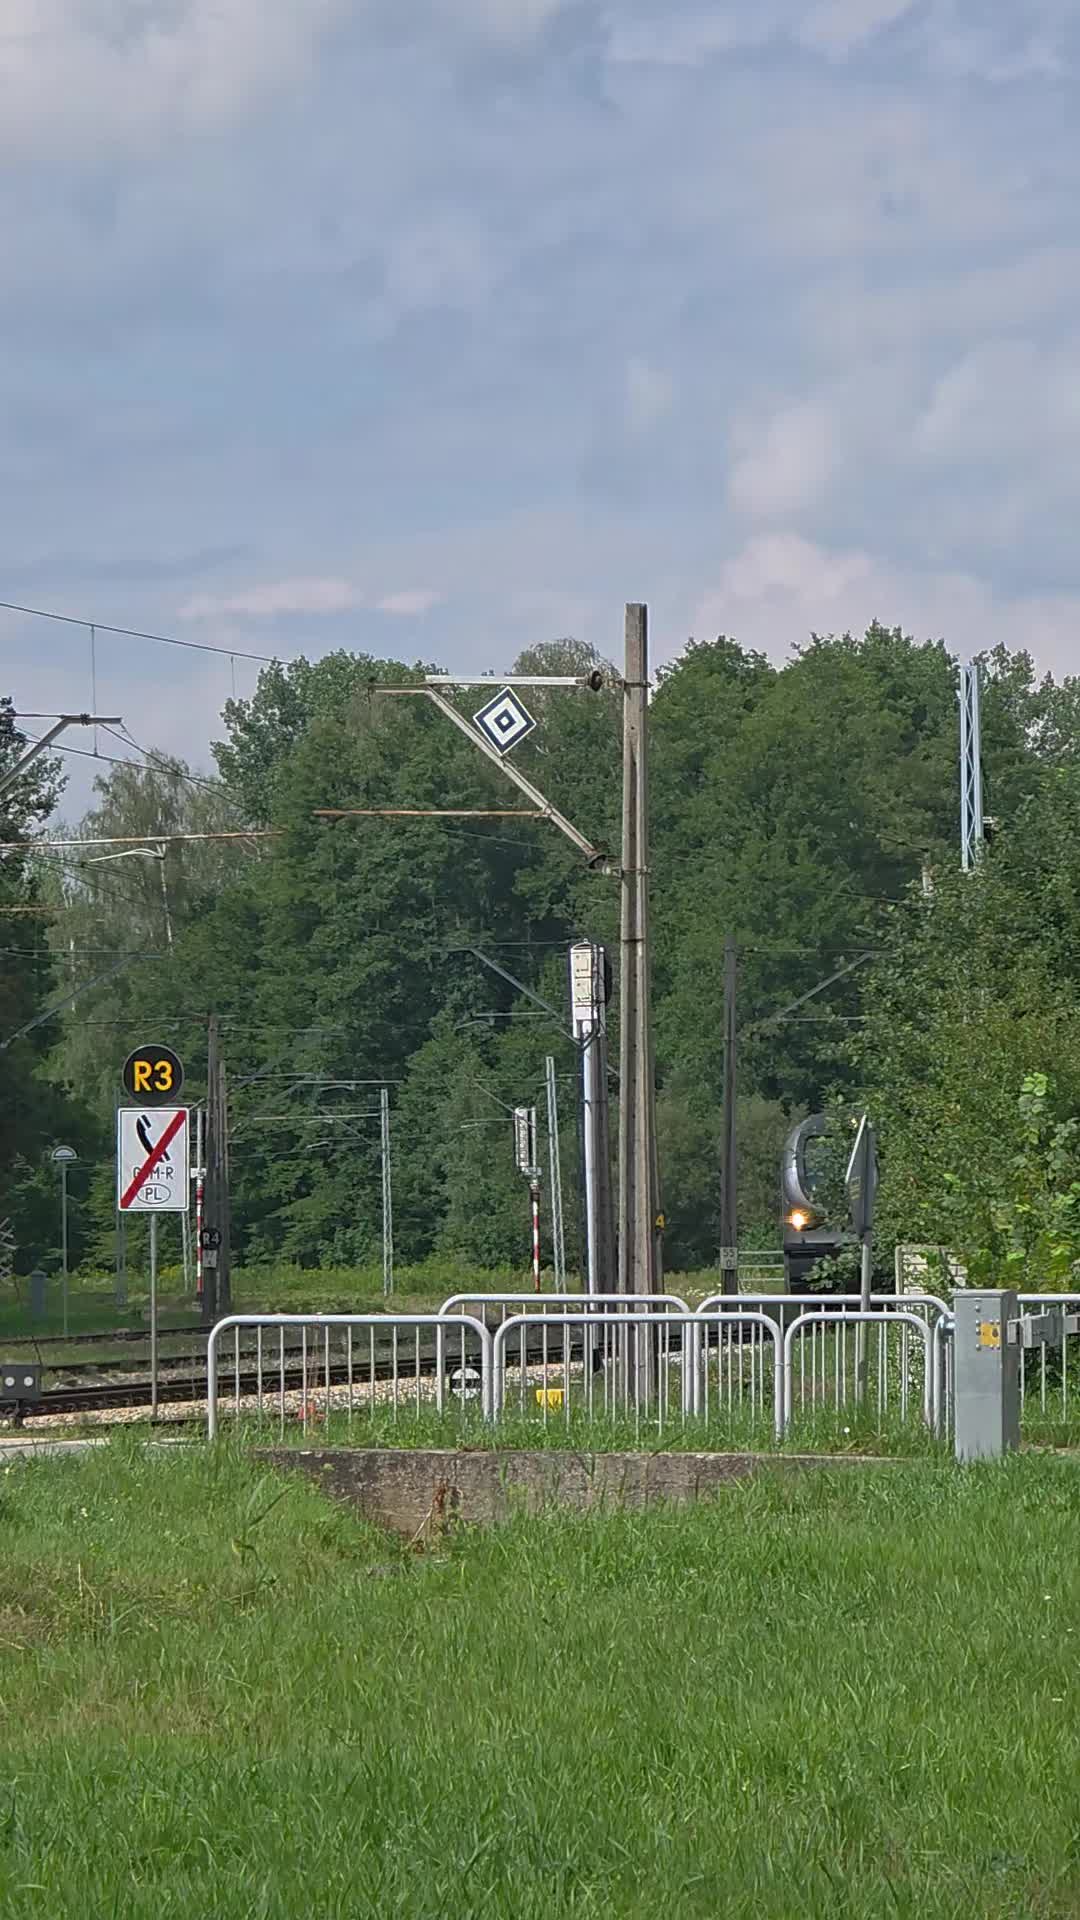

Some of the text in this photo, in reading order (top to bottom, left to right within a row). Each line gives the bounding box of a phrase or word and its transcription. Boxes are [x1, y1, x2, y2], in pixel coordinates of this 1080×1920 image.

[133, 1060, 173, 1092] R3
[133, 1166, 174, 1180] GM-R
[145, 1188, 163, 1200] PL
[203, 1231, 220, 1245] R4
